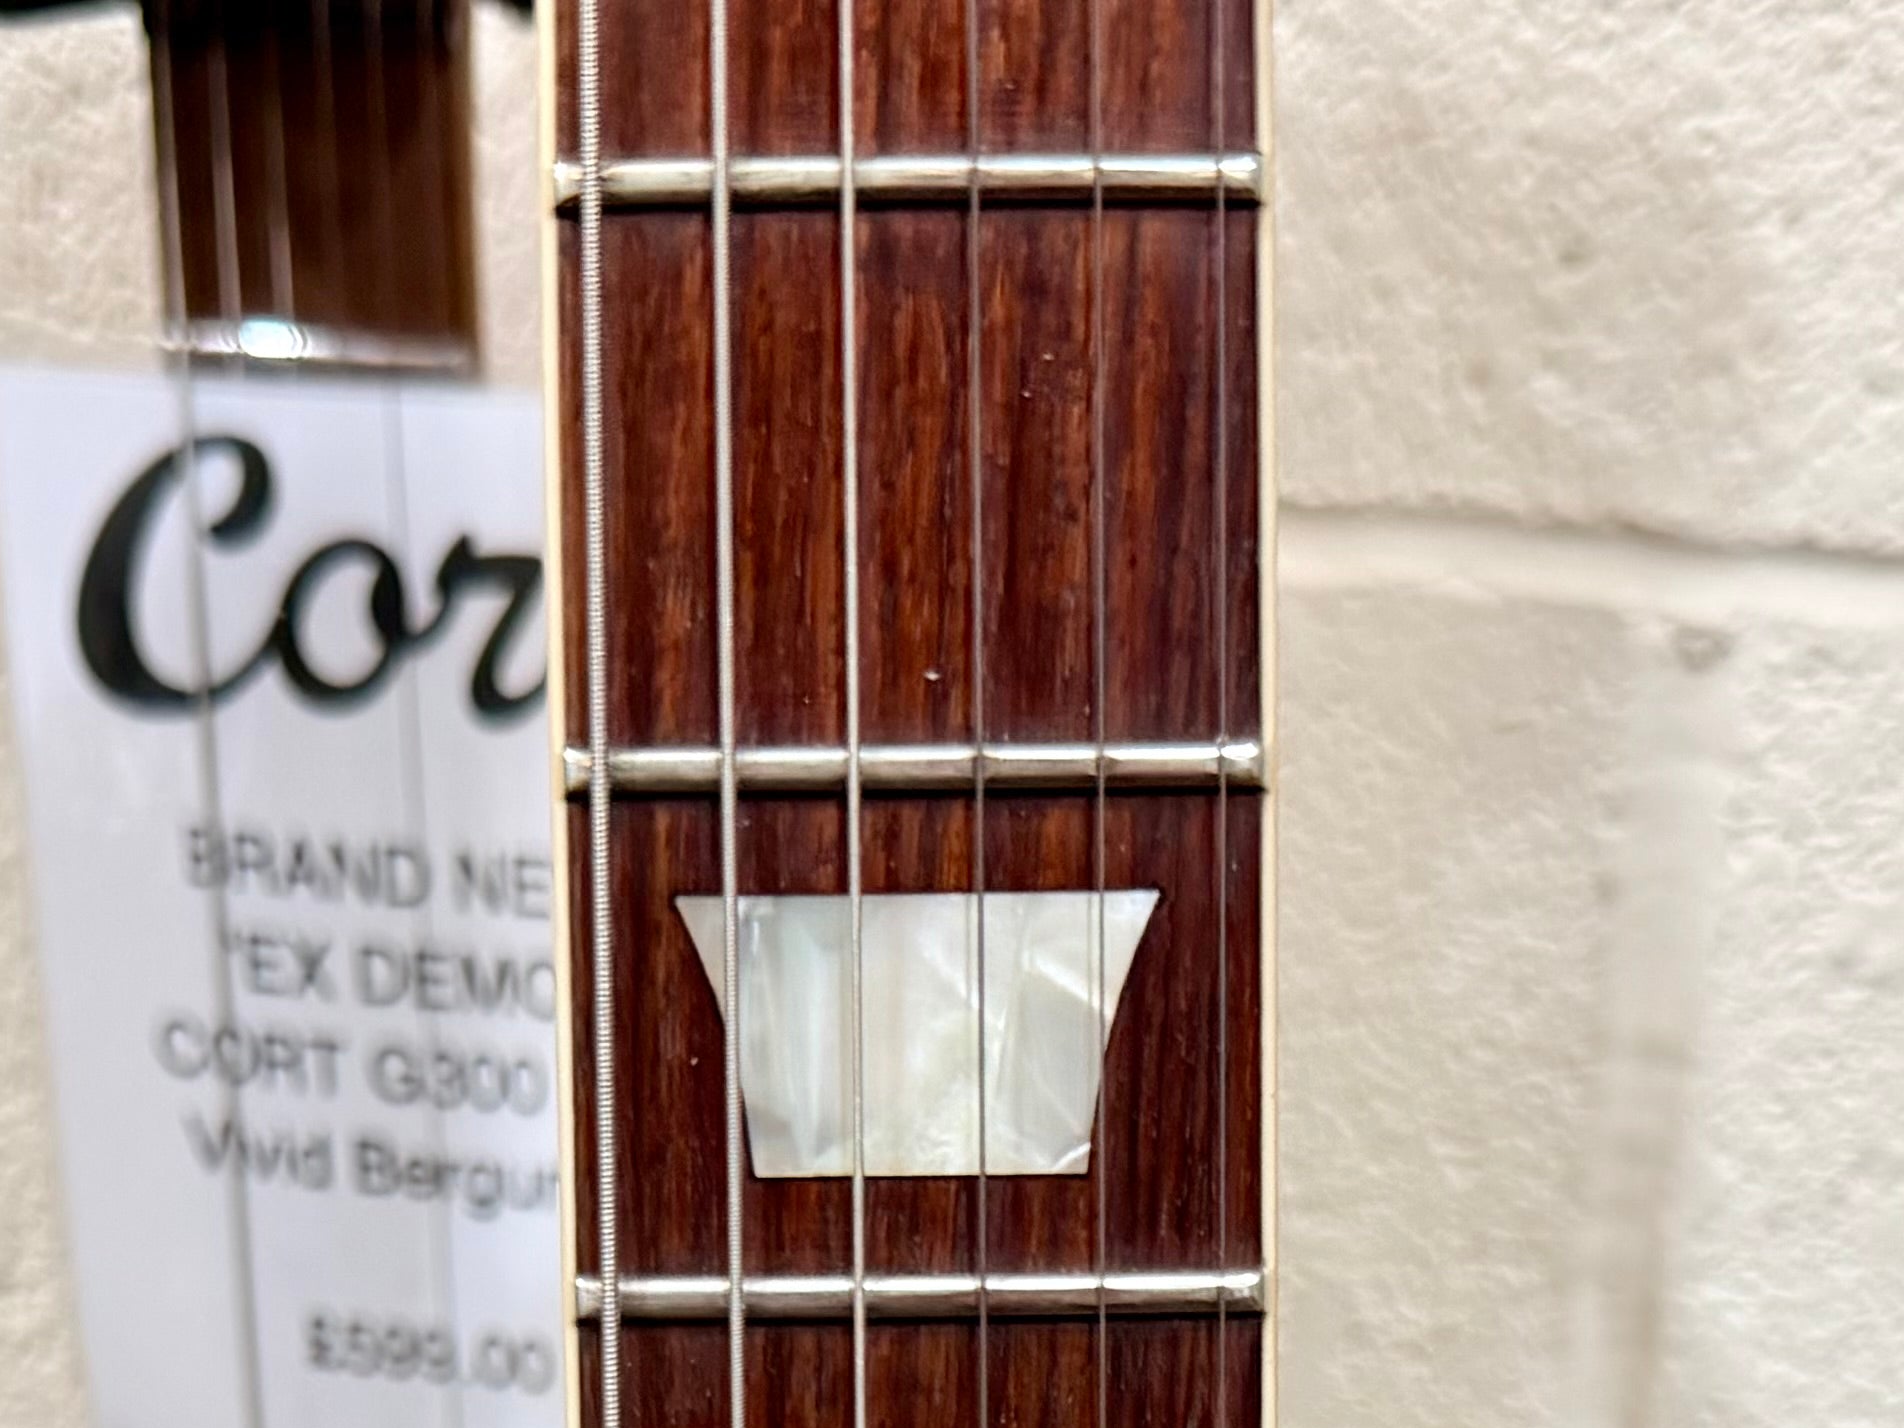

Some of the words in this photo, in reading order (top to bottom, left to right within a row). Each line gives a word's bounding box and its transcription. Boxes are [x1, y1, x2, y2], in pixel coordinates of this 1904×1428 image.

[76, 434, 546, 722] Cor
[187, 826, 433, 909] BRAND
[452, 845, 552, 921] NE
[351, 942, 555, 1022] DEMO
[153, 1019, 346, 1098] CORT
[366, 1046, 548, 1115] G300
[183, 1106, 336, 1191] Vivid
[354, 1136, 556, 1221] Bergu
